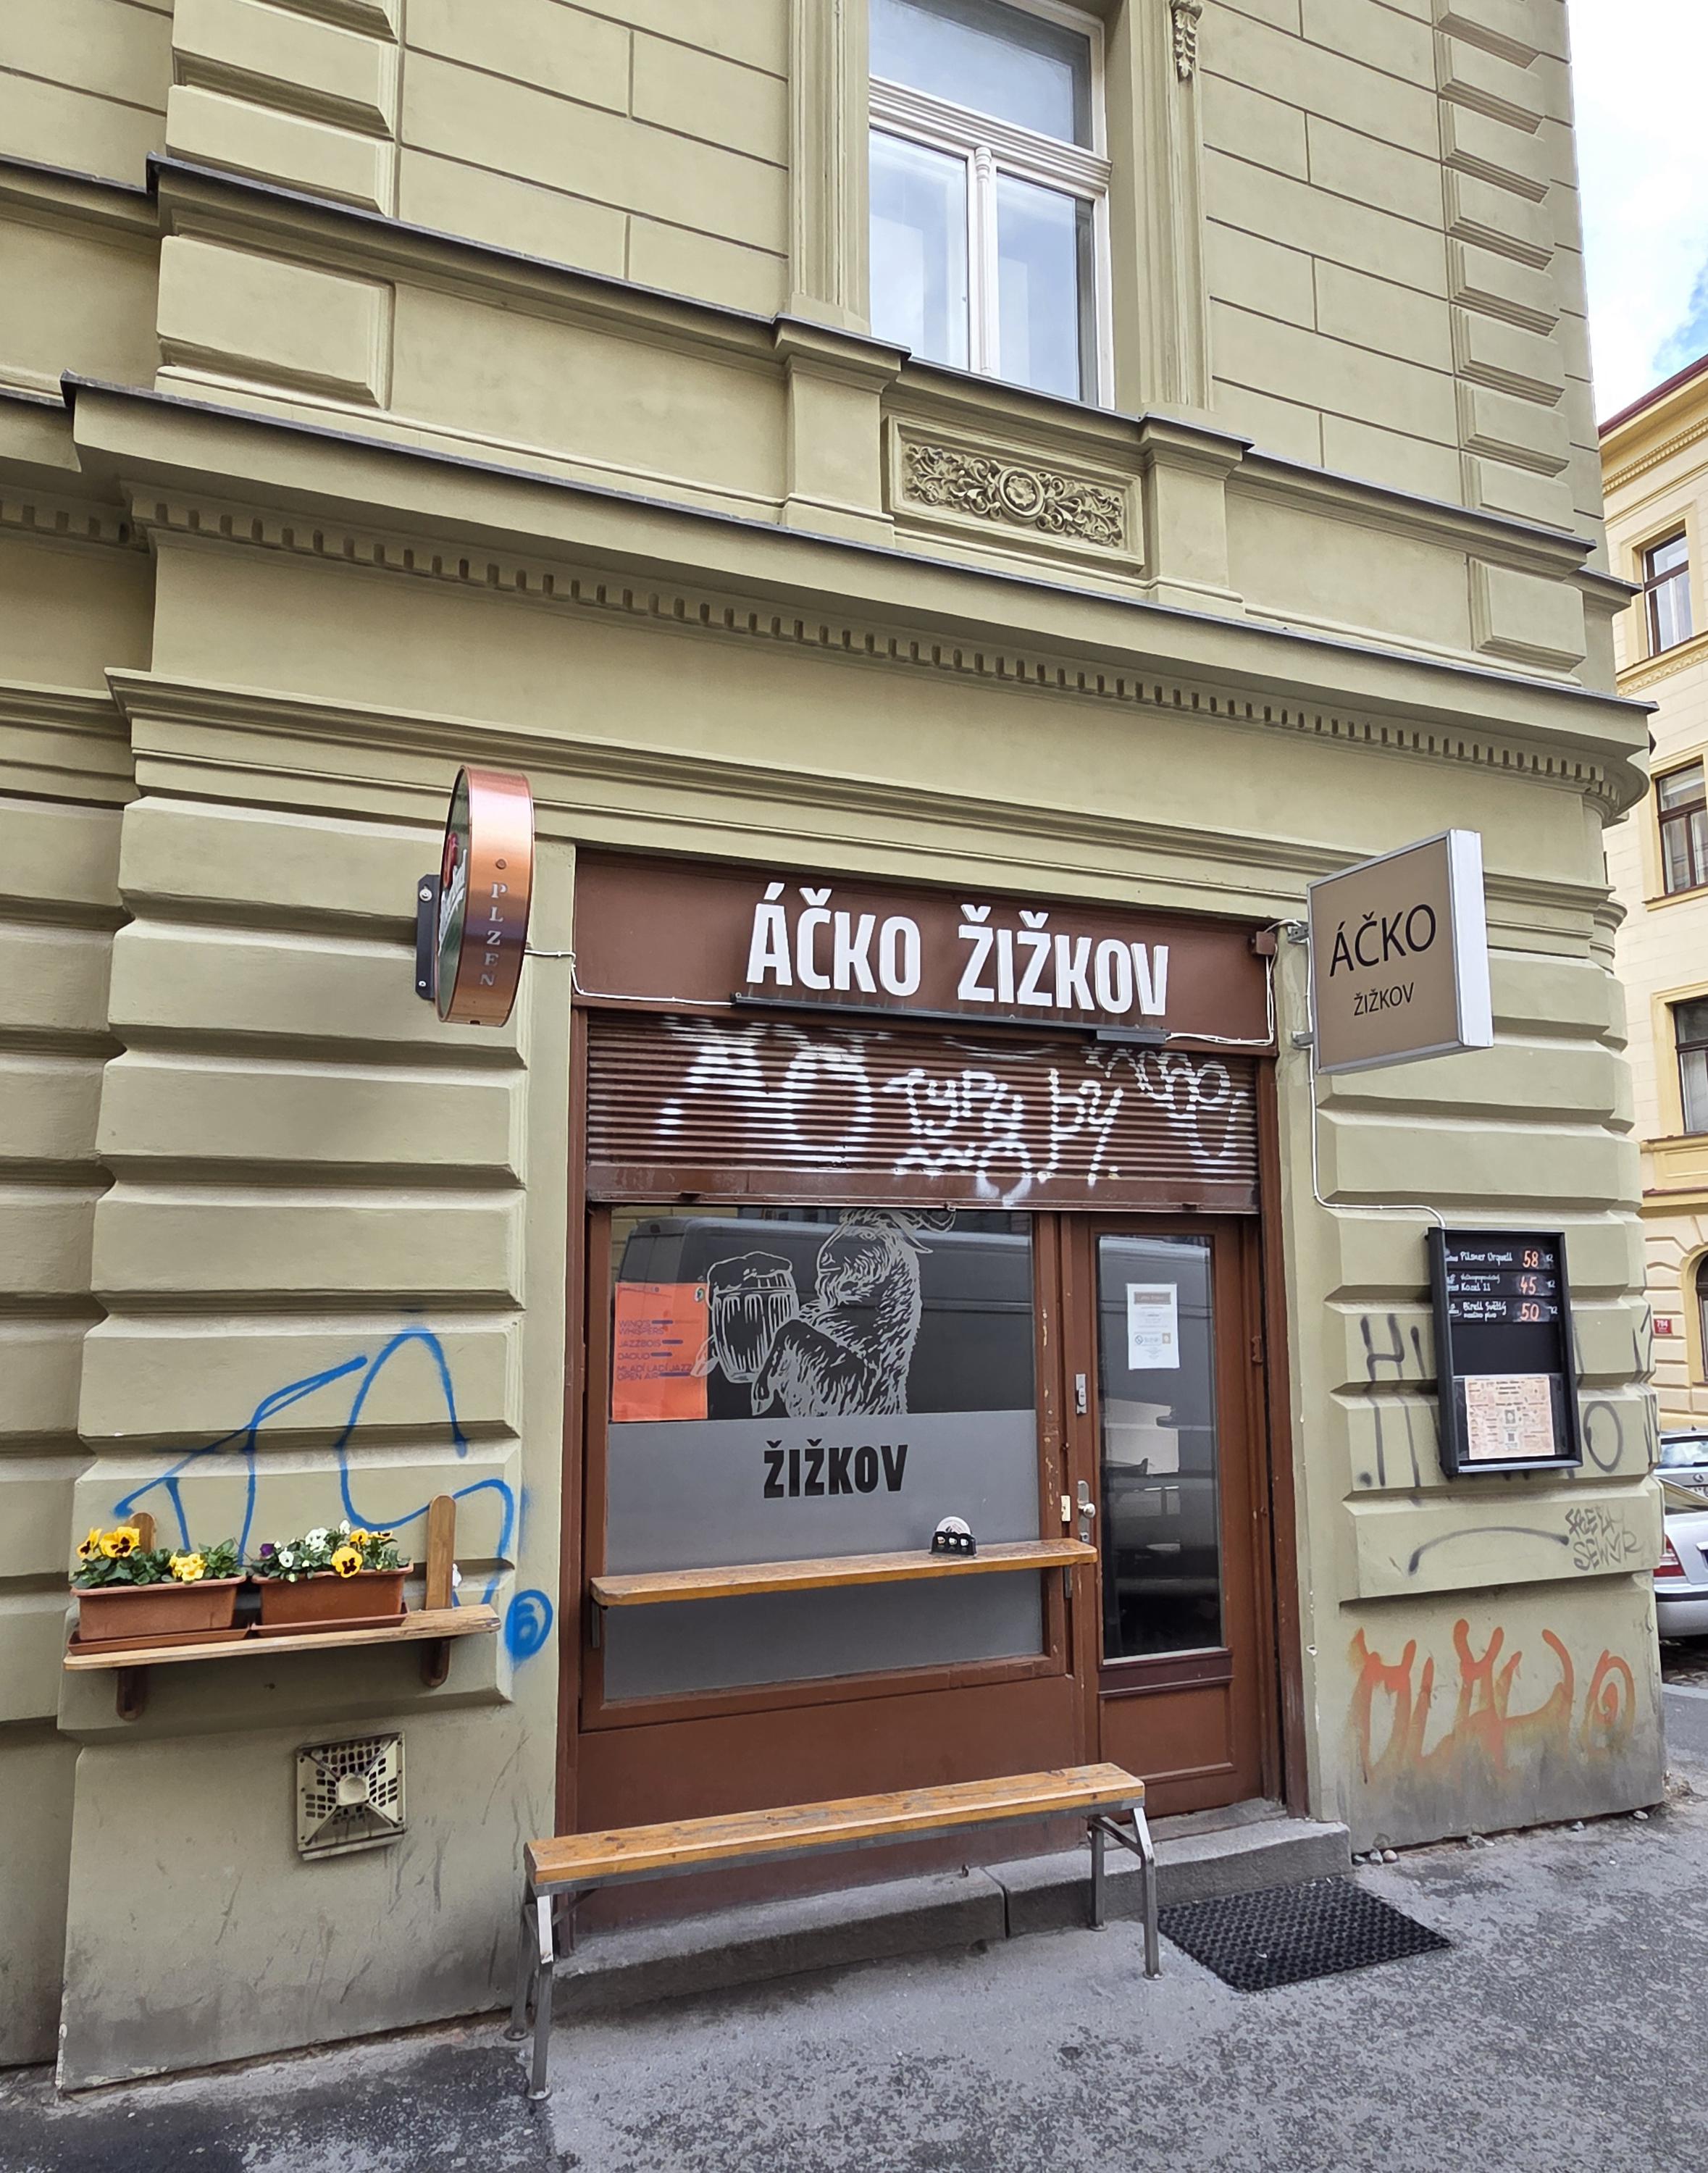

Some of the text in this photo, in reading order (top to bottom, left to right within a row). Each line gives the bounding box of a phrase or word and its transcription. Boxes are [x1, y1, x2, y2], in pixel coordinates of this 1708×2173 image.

[479, 882, 507, 987] PLZEN
[745, 882, 1170, 1016] ÁČKO ŽIŽKOV
[1329, 903, 1436, 978] ÁČKO
[1353, 982, 1415, 1016] ŽIŽKOV
[1522, 1250, 1539, 1268] 58
[1520, 1276, 1537, 1295] 45
[1520, 1302, 1540, 1322] 50
[763, 1438, 909, 1499] ŽIŽKOV
